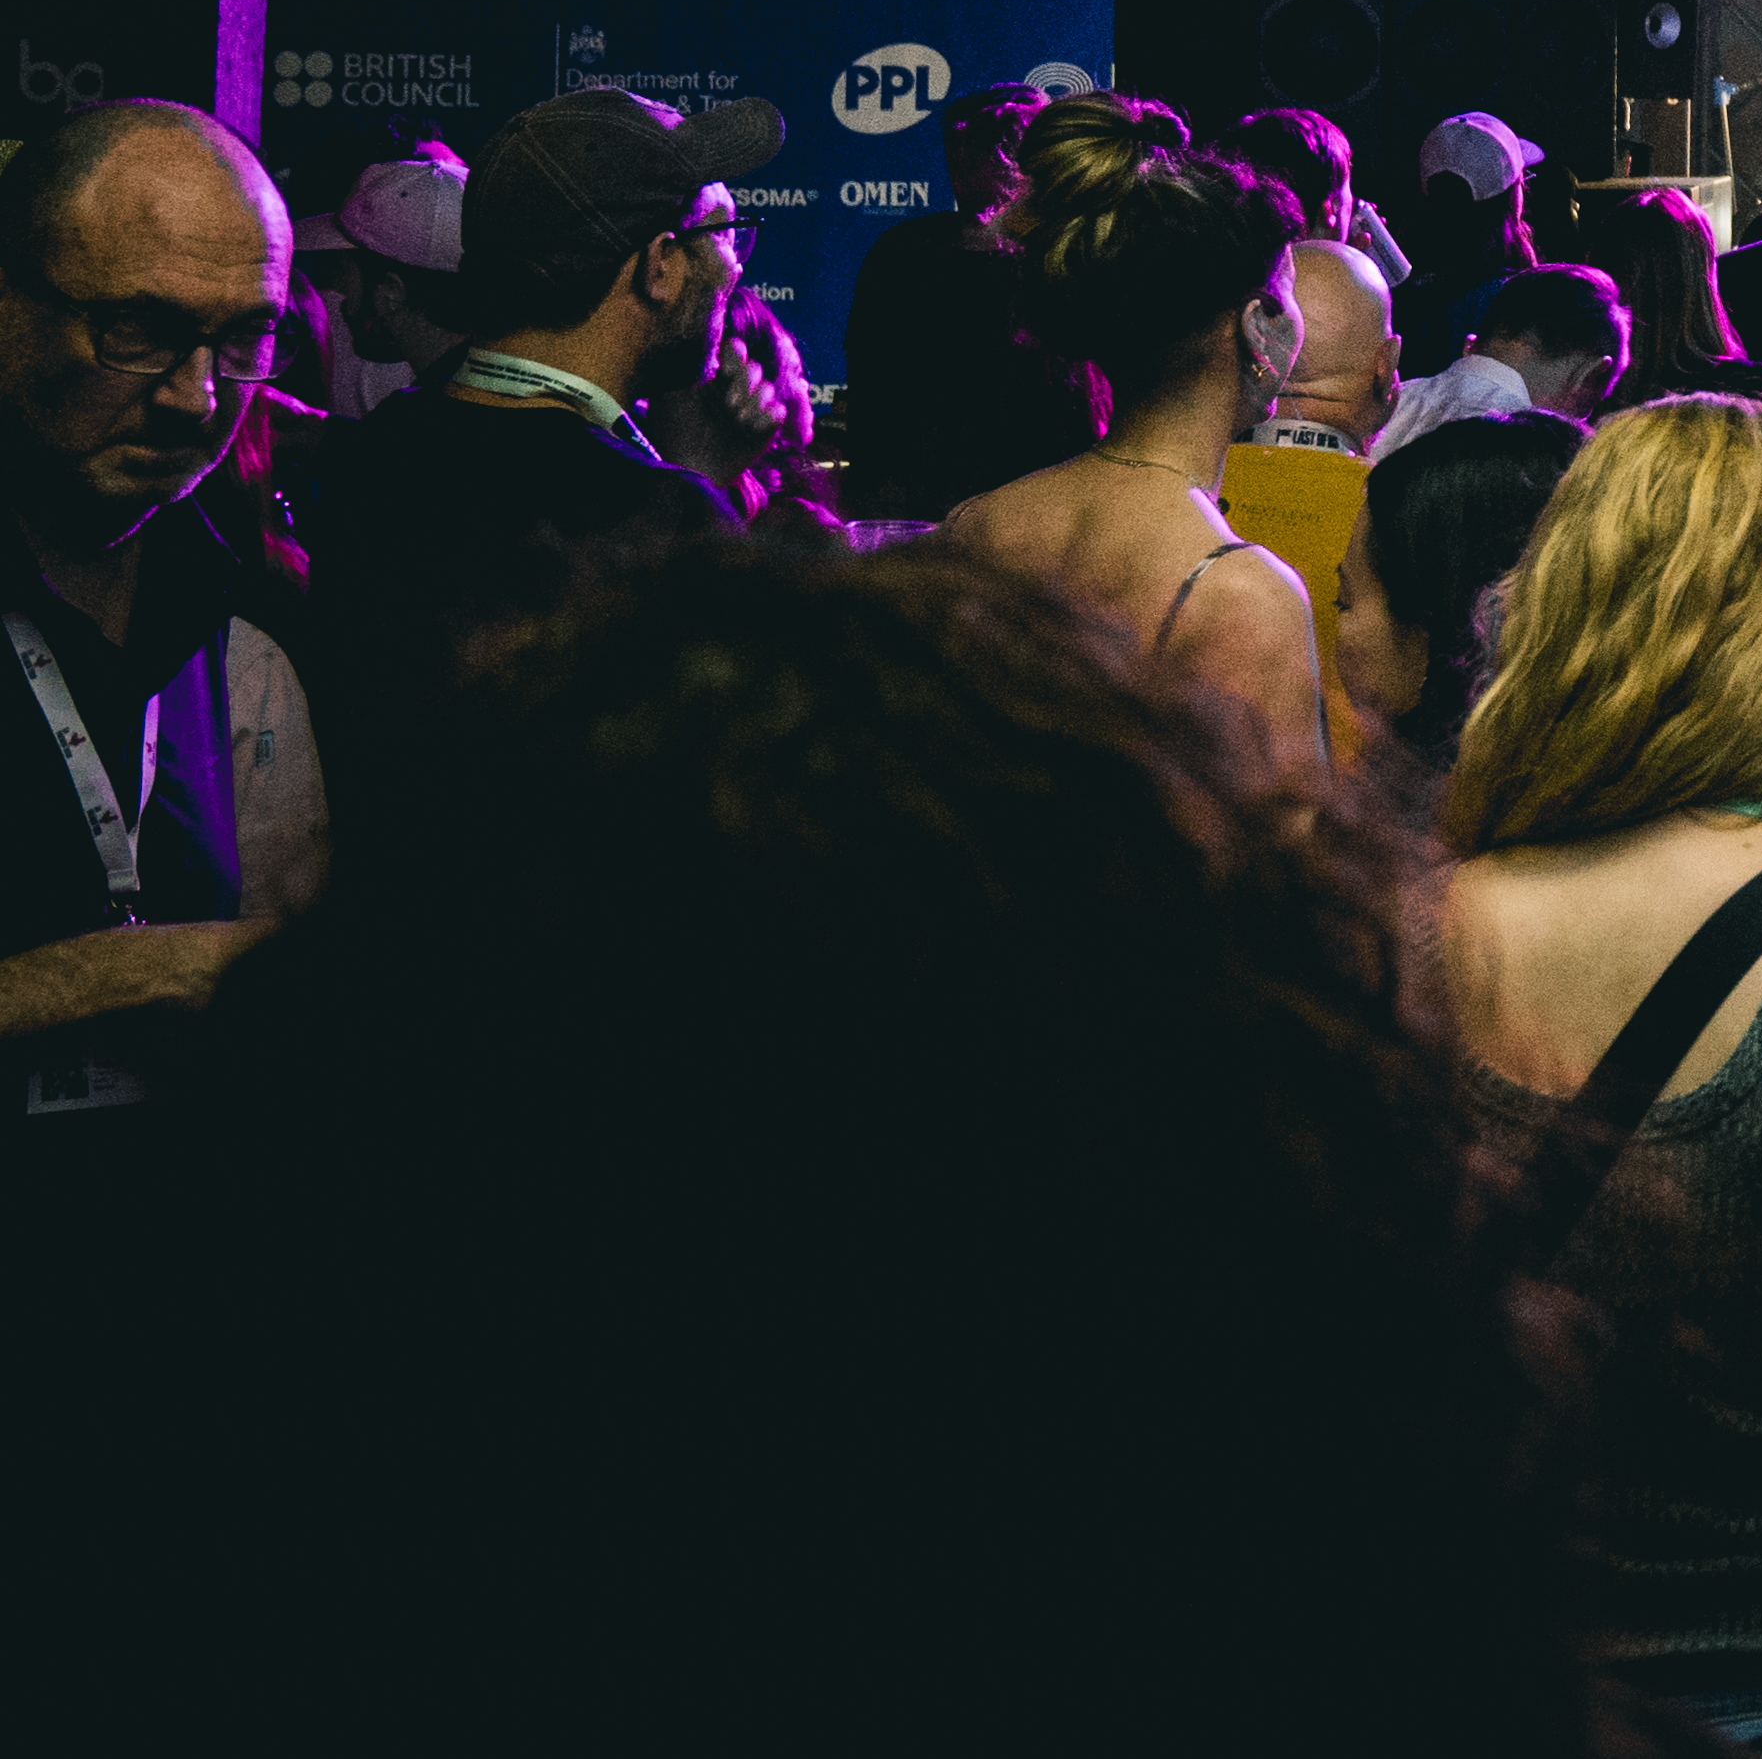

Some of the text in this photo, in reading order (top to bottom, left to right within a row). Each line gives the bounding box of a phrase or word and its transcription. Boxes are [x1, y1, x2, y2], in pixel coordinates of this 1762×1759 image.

[343, 53, 473, 79] BRITISH
[566, 68, 739, 90] Department for
[341, 81, 480, 108] COUNCIL
[846, 66, 947, 111] PPL
[839, 180, 930, 207] OMEN
